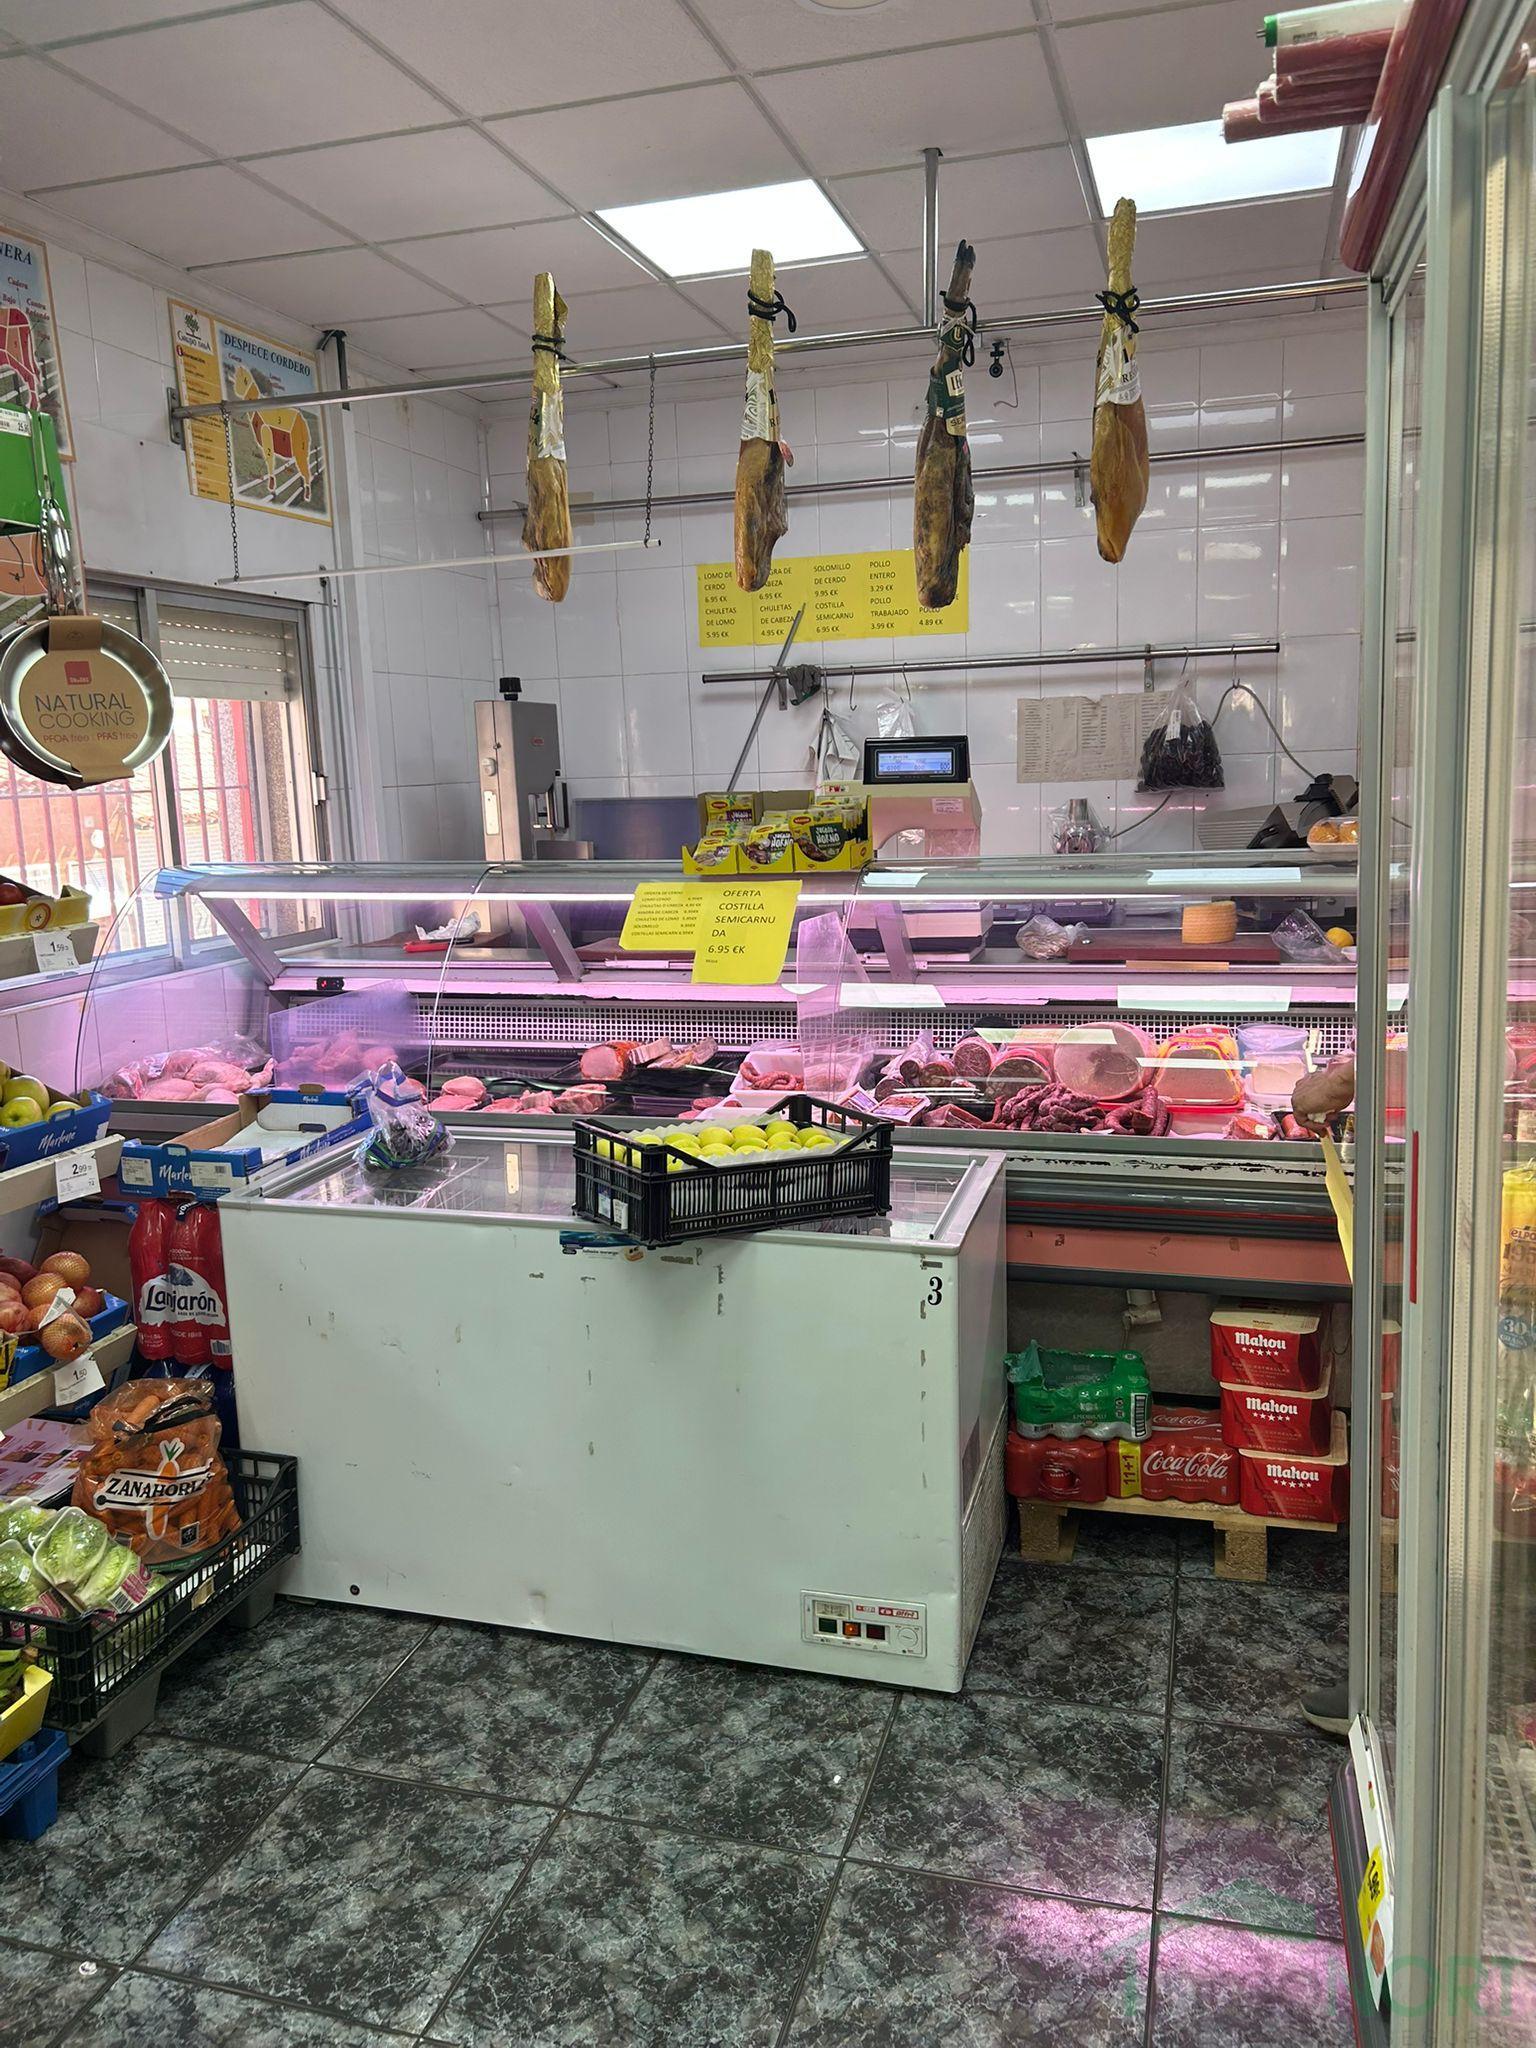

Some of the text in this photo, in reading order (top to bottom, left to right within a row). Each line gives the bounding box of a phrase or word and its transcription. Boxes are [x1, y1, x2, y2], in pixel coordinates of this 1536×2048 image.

[224, 333, 268, 361] DESPIECE
[270, 354, 311, 377] CORDERO
[814, 563, 851, 572] SOLOMILLO
[824, 576, 846, 584] CERDO
[870, 572, 896, 580] ENTERO
[760, 604, 792, 612] CHULETAS
[815, 602, 845, 610] COSTILLA
[705, 607, 737, 615] CHULETAS
[870, 608, 909, 617] TRABAJADO
[770, 616, 794, 624] CABEZA
[816, 612, 854, 621] SEMICARNU
[35, 692, 132, 712] NATURAL
[39, 710, 135, 729] COOKING
[43, 734, 68, 743] PFOA
[96, 732, 118, 741] PFAS
[722, 890, 762, 898] OFERTA
[718, 902, 764, 911] COSTILLA
[714, 916, 776, 924] SEMICARNU
[712, 929, 726, 938] DA
[708, 944, 746, 954] 6.95 €K
[38, 1129, 76, 1155] Marlene
[928, 1276, 942, 1306] 3
[145, 1285, 216, 1313] Lanjarón
[1234, 1332, 1286, 1350] Mahou
[1246, 1396, 1298, 1415] Mahou
[1143, 1450, 1232, 1478] Coca-Cola
[1122, 1454, 1136, 1486] 11+1
[1266, 1464, 1320, 1482] Mahou
